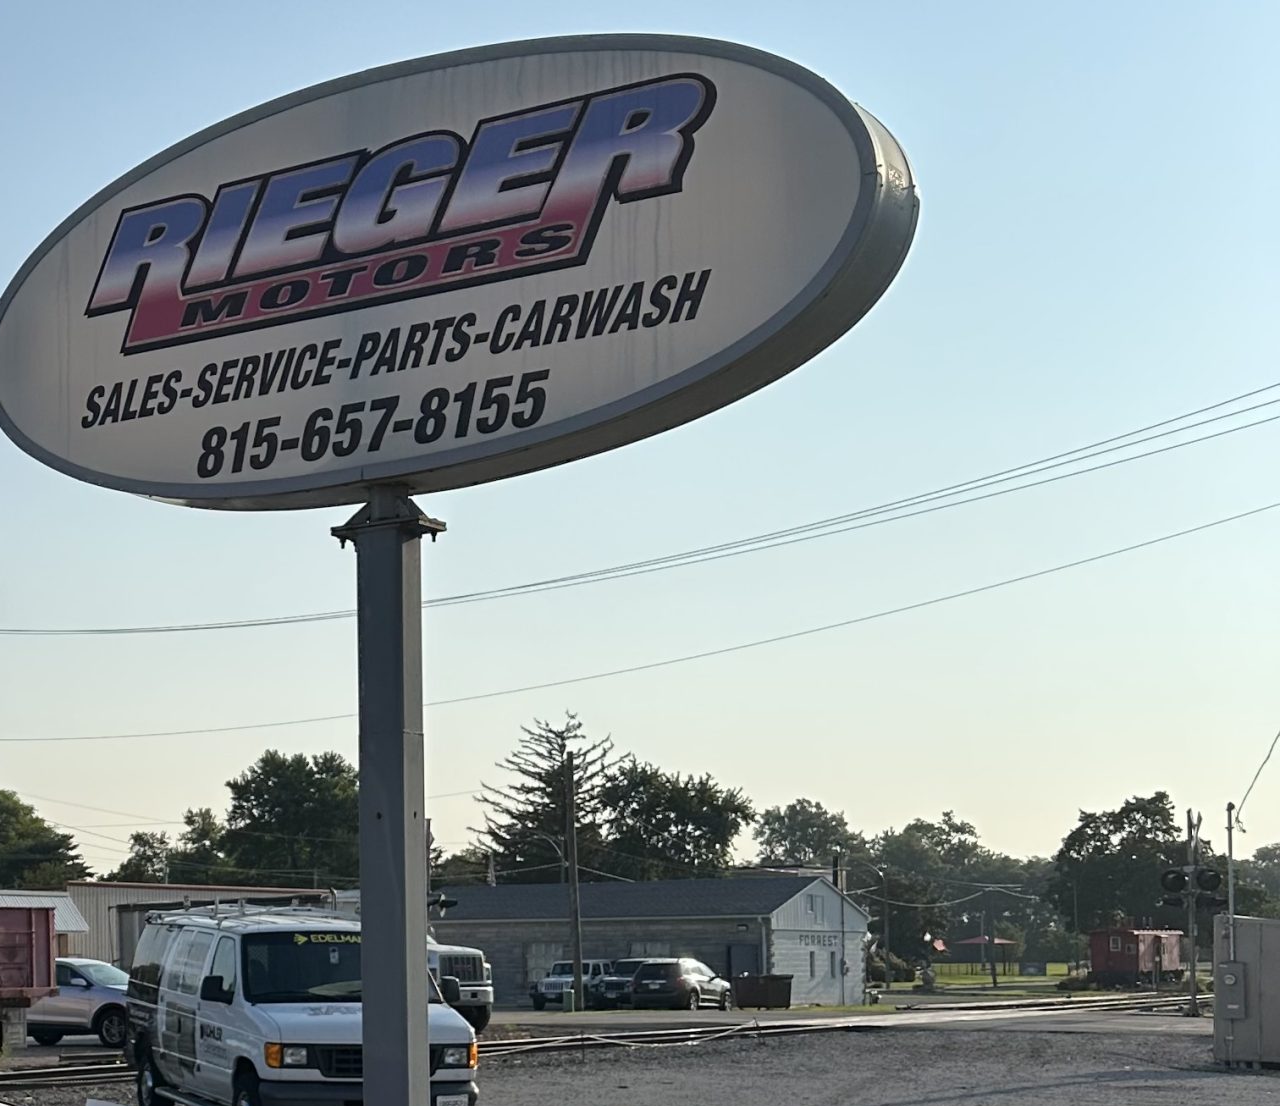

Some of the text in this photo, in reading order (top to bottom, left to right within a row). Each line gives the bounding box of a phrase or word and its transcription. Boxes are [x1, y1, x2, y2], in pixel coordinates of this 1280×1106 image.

[84, 72, 717, 318] RIEGER
[179, 224, 574, 328] MOTORS
[81, 268, 712, 429] SALES-SERVICE-PARTS-CARWASH
[196, 369, 551, 479] 815-657-8155
[310, 934, 362, 943] EDELMA
[799, 934, 838, 947] FORREST
